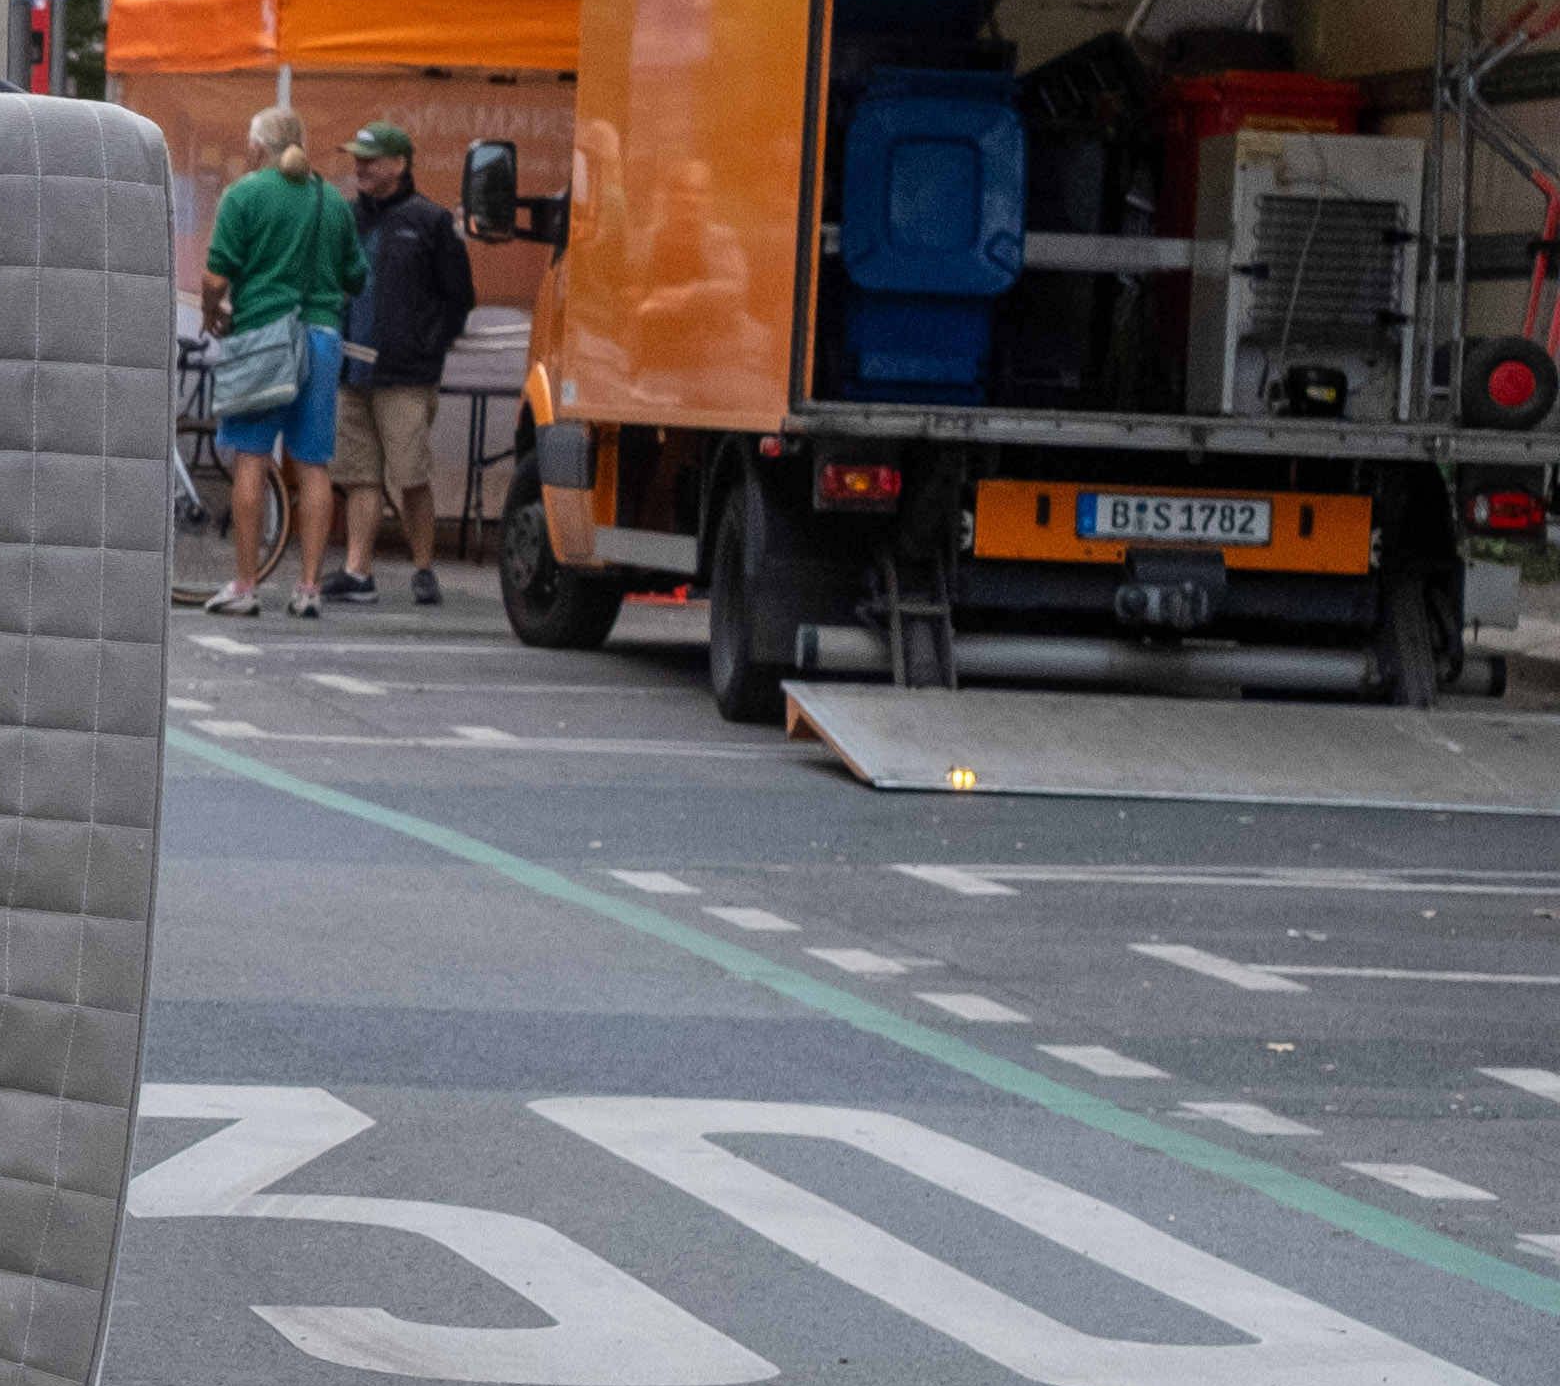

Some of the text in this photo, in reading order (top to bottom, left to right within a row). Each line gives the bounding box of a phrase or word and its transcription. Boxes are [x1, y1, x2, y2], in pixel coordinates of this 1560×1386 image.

[1111, 501, 1257, 535] B S 1782
